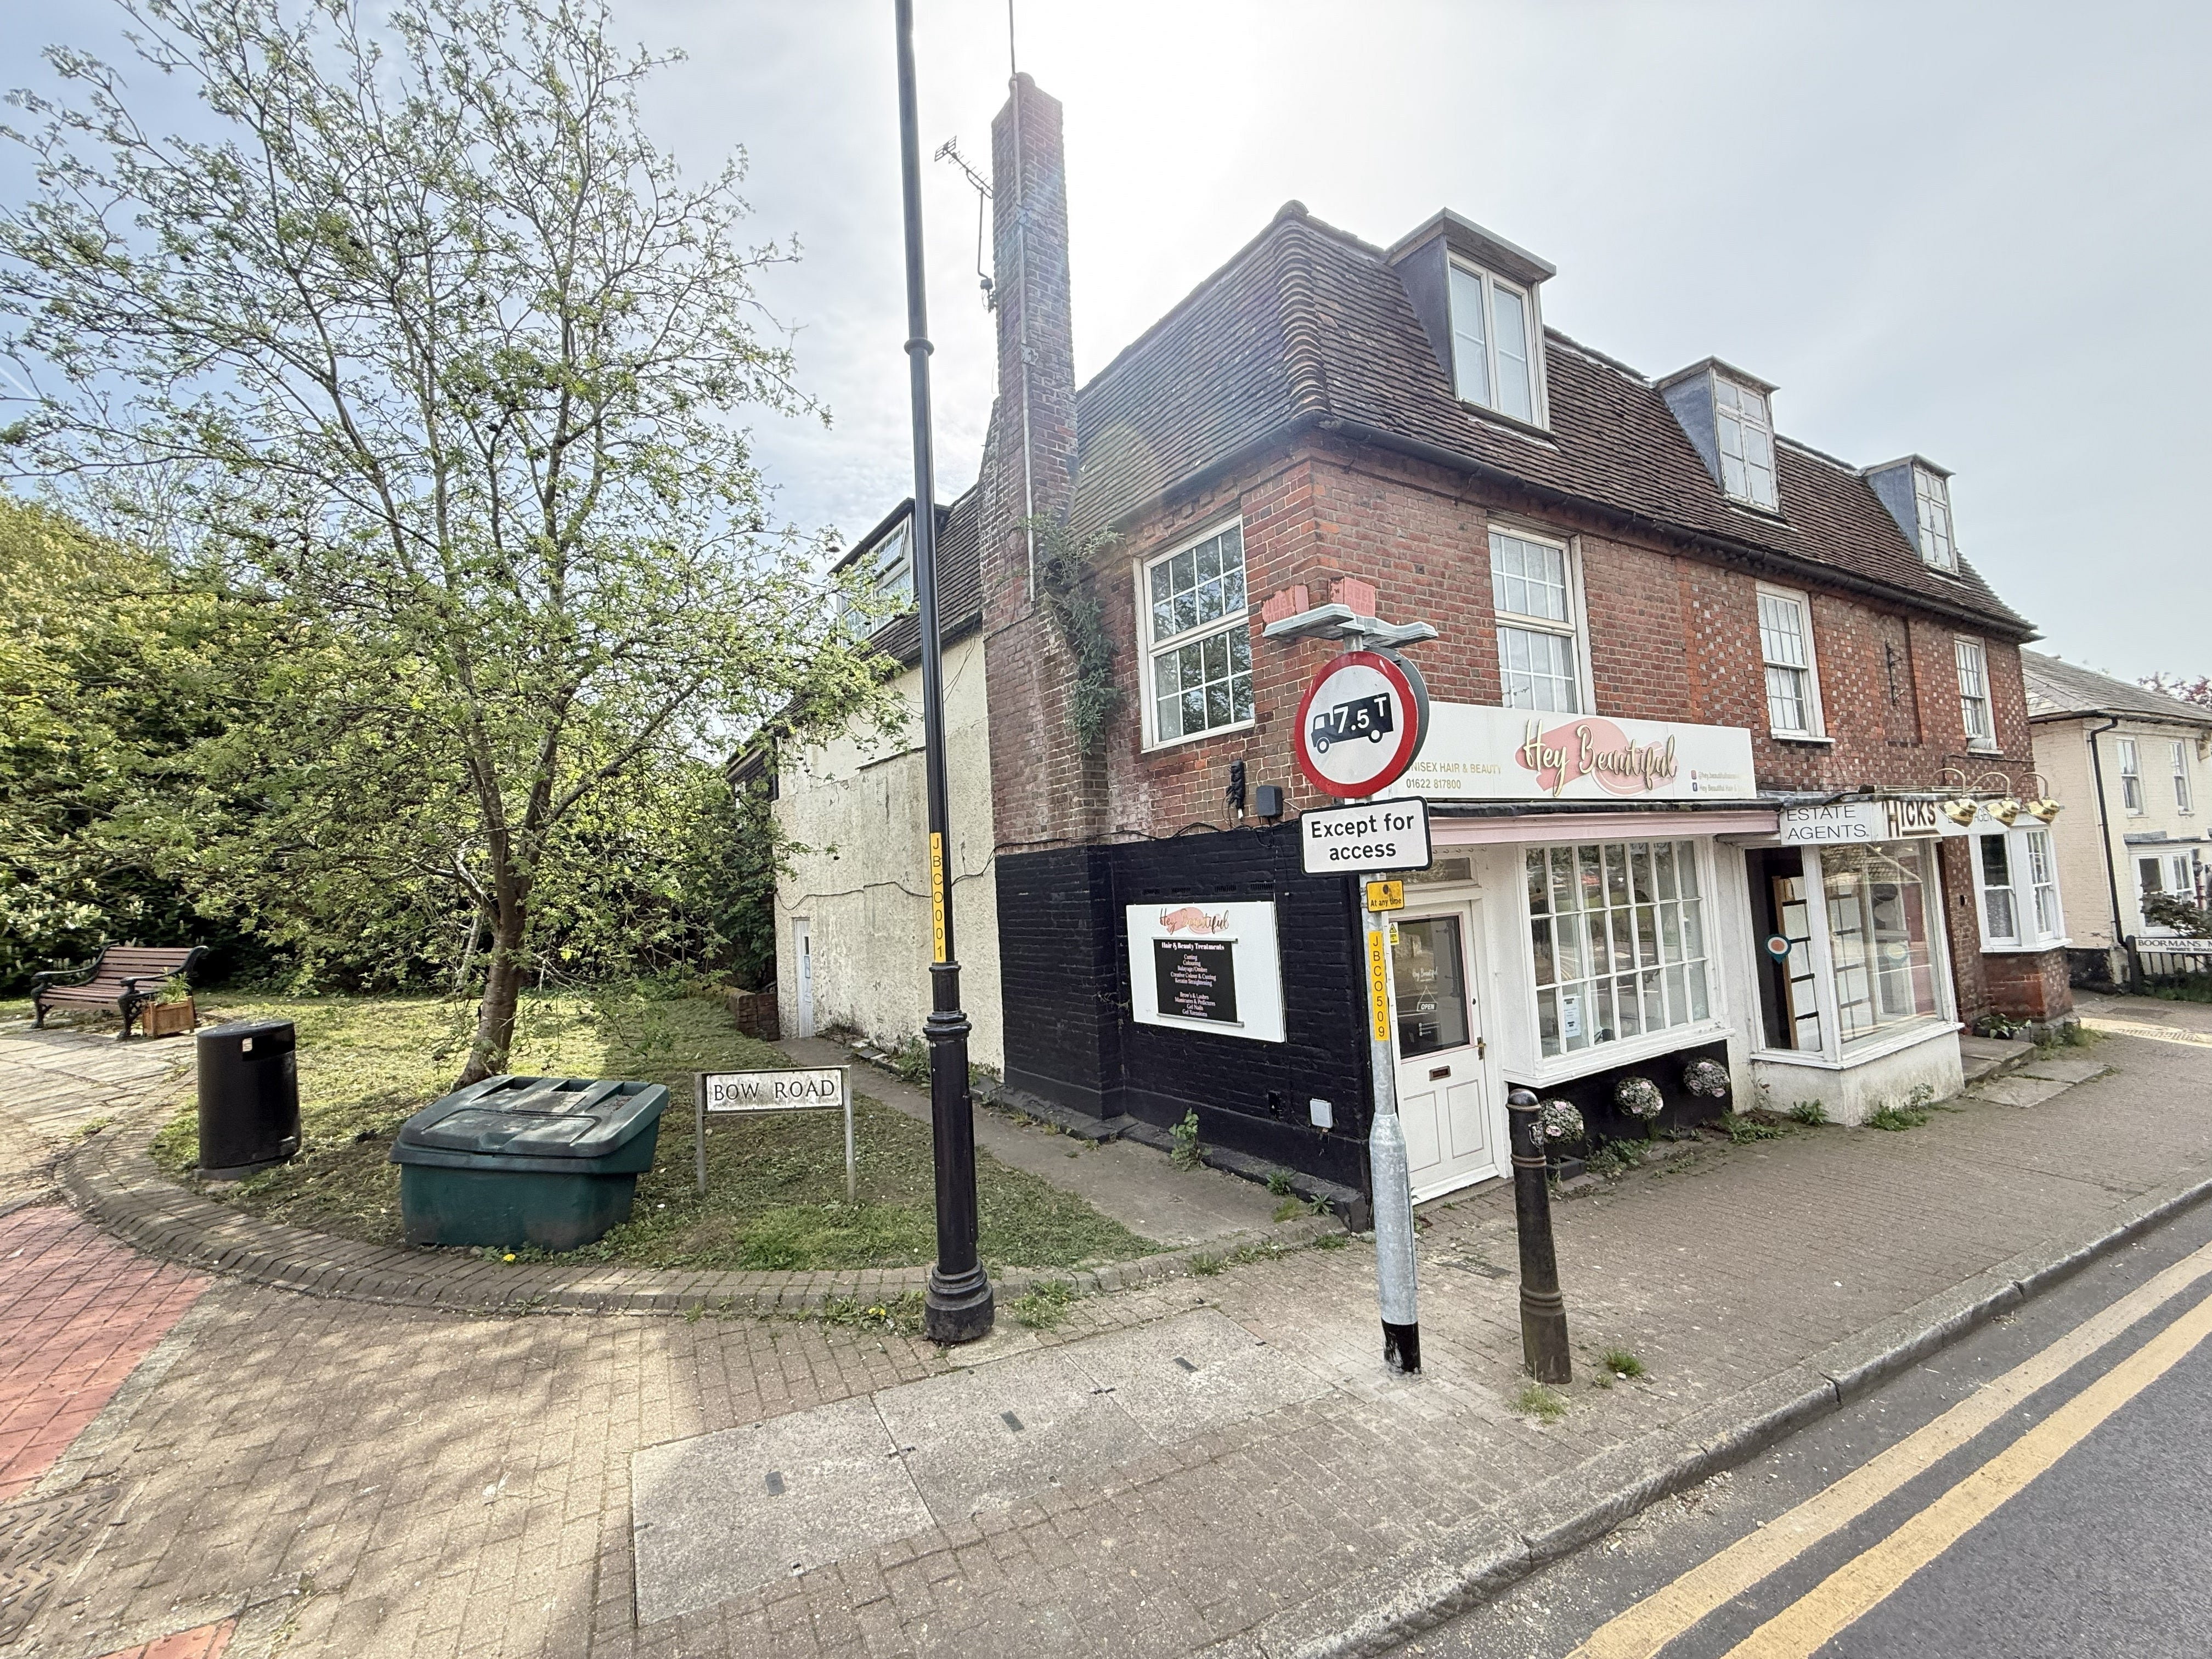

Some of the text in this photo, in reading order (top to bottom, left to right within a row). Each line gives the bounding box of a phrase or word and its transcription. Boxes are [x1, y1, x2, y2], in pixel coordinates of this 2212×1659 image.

[1523, 719, 1678, 797] Hey Beautiful
[1408, 761, 1501, 774] NISEX HAIR & BEAUTY
[1406, 778, 1461, 789] 01622 817800
[1787, 805, 1856, 821] ESTATE
[1884, 801, 1937, 838] HICKS
[1311, 813, 1414, 838] Except for
[1788, 824, 1866, 840] AGENTS
[1329, 843, 1396, 861] access
[1160, 908, 1229, 935] Hey Beautiful
[1177, 942, 1194, 951] Beauty
[714, 1080, 834, 1101] BOW ROAD
